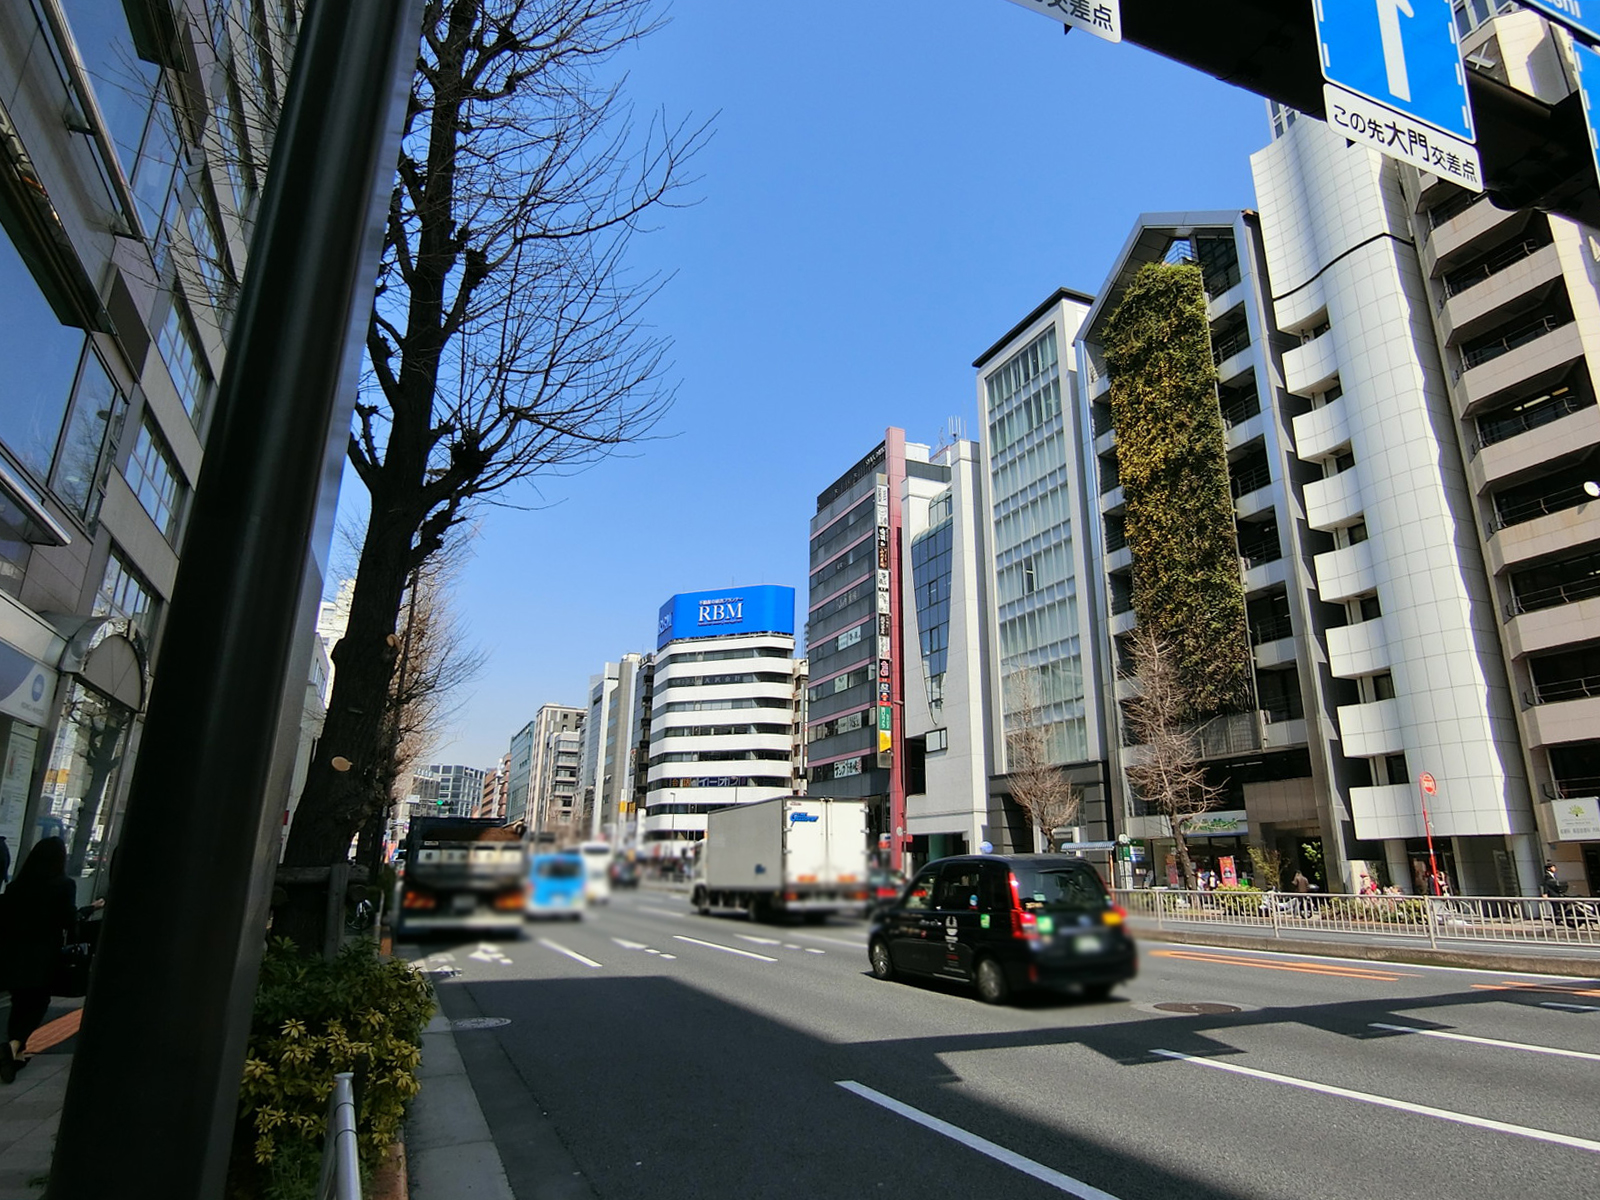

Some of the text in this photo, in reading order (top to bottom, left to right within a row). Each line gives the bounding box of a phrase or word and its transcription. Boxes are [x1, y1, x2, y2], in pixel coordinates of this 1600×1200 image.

[1036, 0, 1114, 32] 交差点
[1333, 104, 1478, 184] この先大門交差点
[699, 602, 743, 621] RBM
